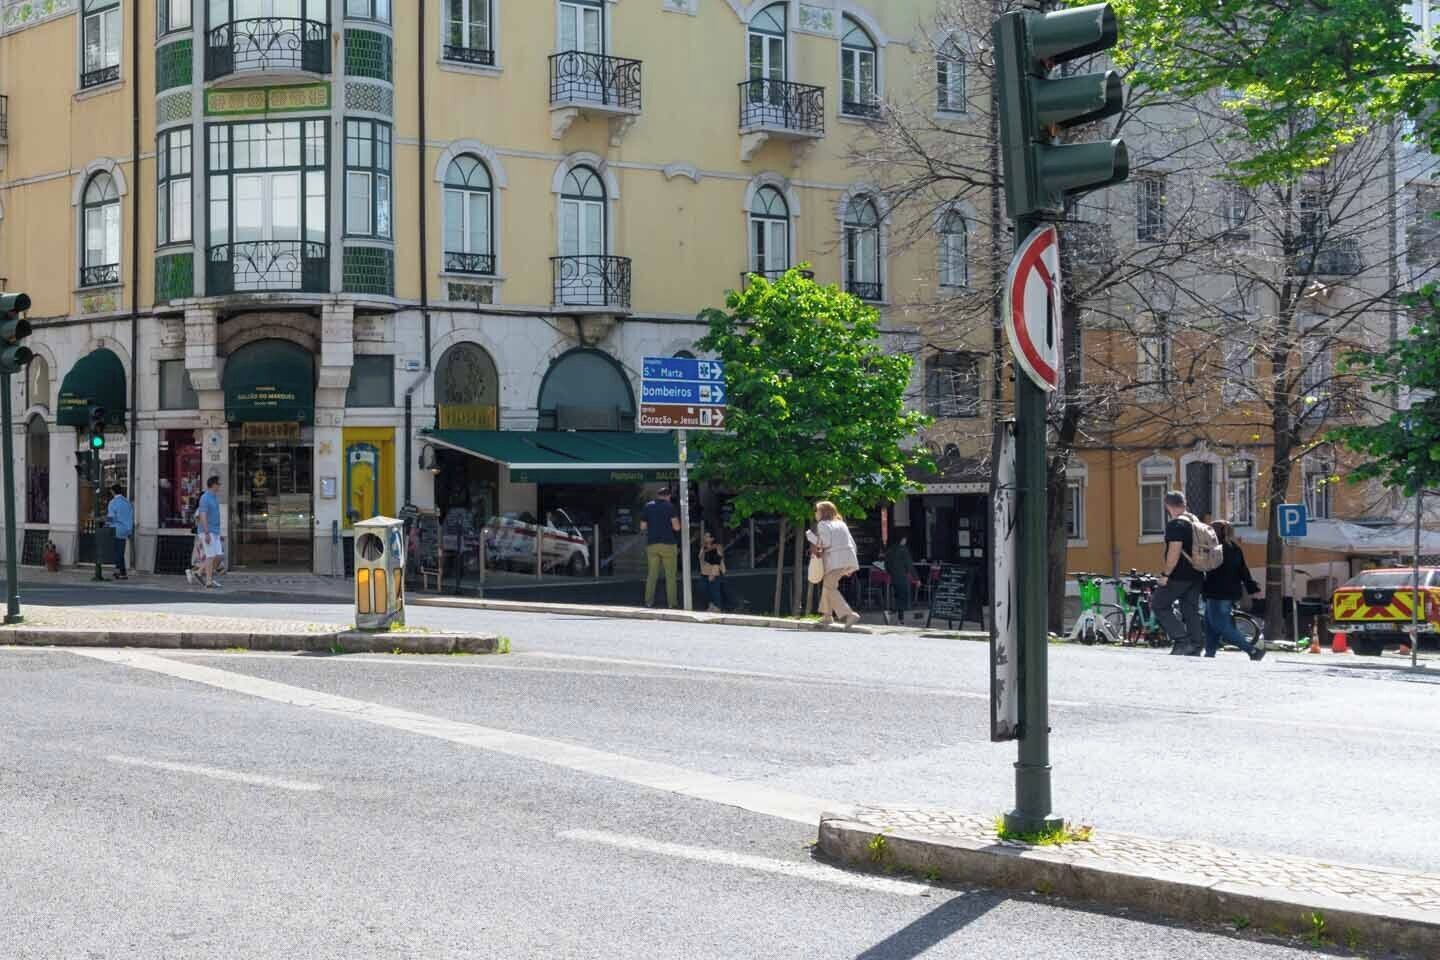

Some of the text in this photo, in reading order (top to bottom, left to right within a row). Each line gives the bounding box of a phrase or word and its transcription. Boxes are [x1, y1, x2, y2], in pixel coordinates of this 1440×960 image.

[661, 368, 683, 378] Marta
[643, 386, 692, 397] bombeiros
[679, 415, 699, 425] Jesus
[1285, 508, 1300, 534] P
